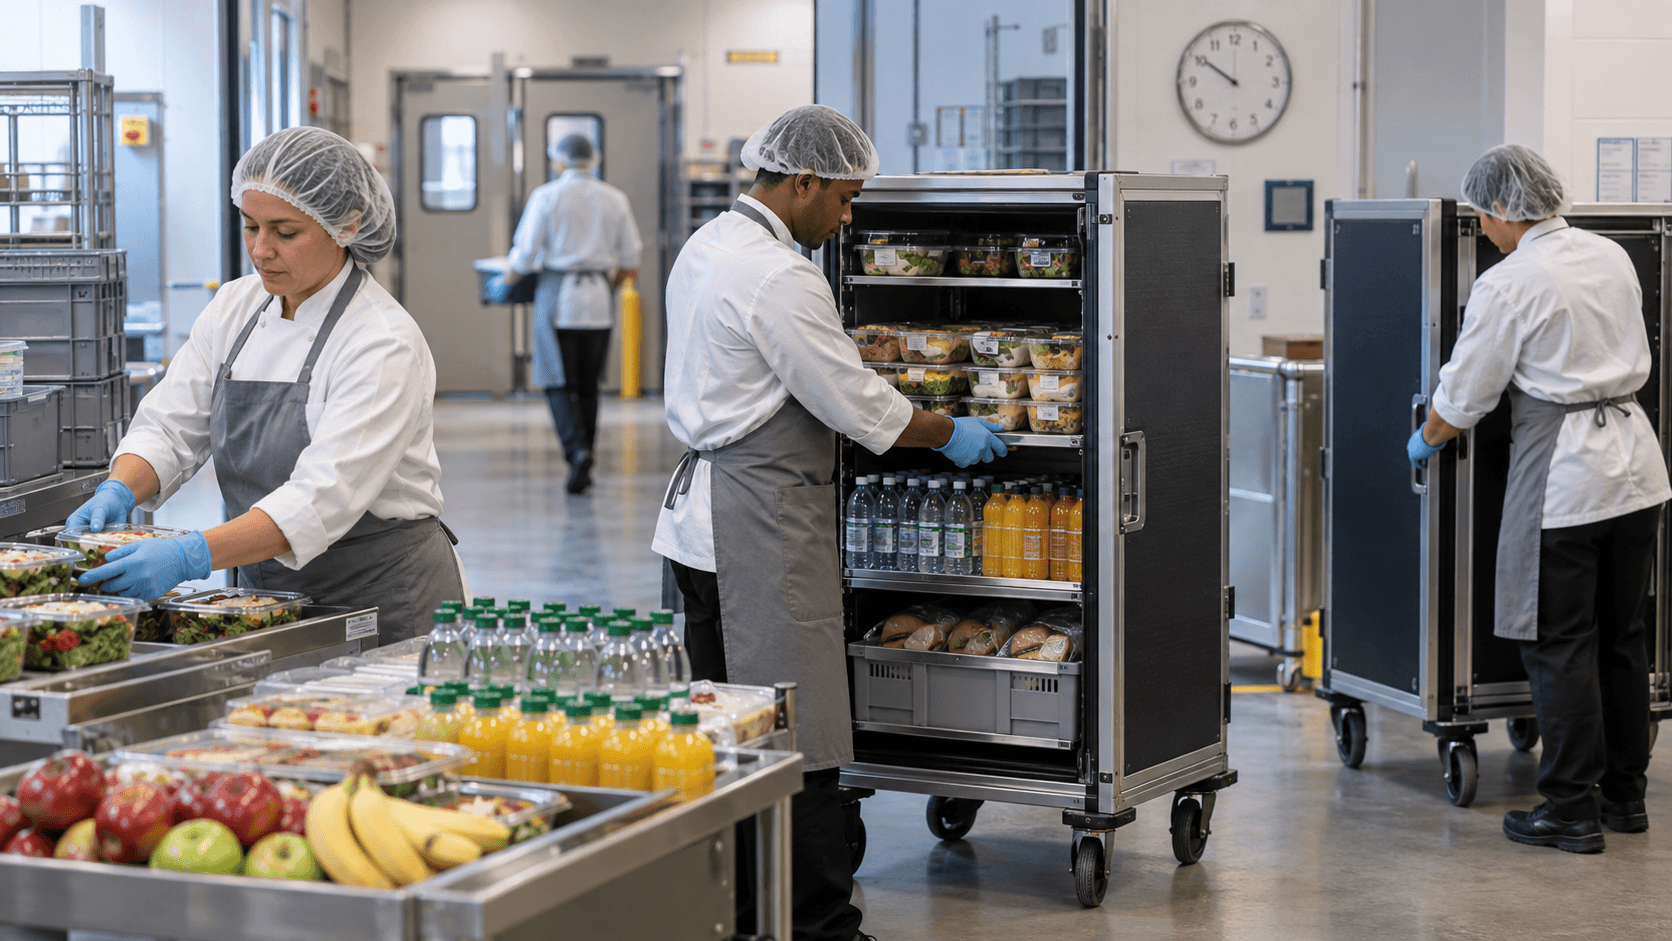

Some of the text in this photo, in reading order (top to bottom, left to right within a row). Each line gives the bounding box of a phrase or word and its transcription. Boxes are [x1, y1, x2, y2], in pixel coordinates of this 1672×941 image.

[1211, 40, 1220, 51] 11
[1229, 34, 1242, 46] 12
[1253, 40, 1258, 51] 1
[1195, 55, 1208, 67] 10
[1265, 54, 1274, 67] 2
[1189, 75, 1197, 88] 9
[1271, 76, 1280, 89] 3
[1195, 97, 1204, 110] 8
[1265, 98, 1273, 110] 4
[1211, 112, 1219, 125] 7
[1229, 118, 1238, 131] 6
[1250, 113, 1258, 126] 5
